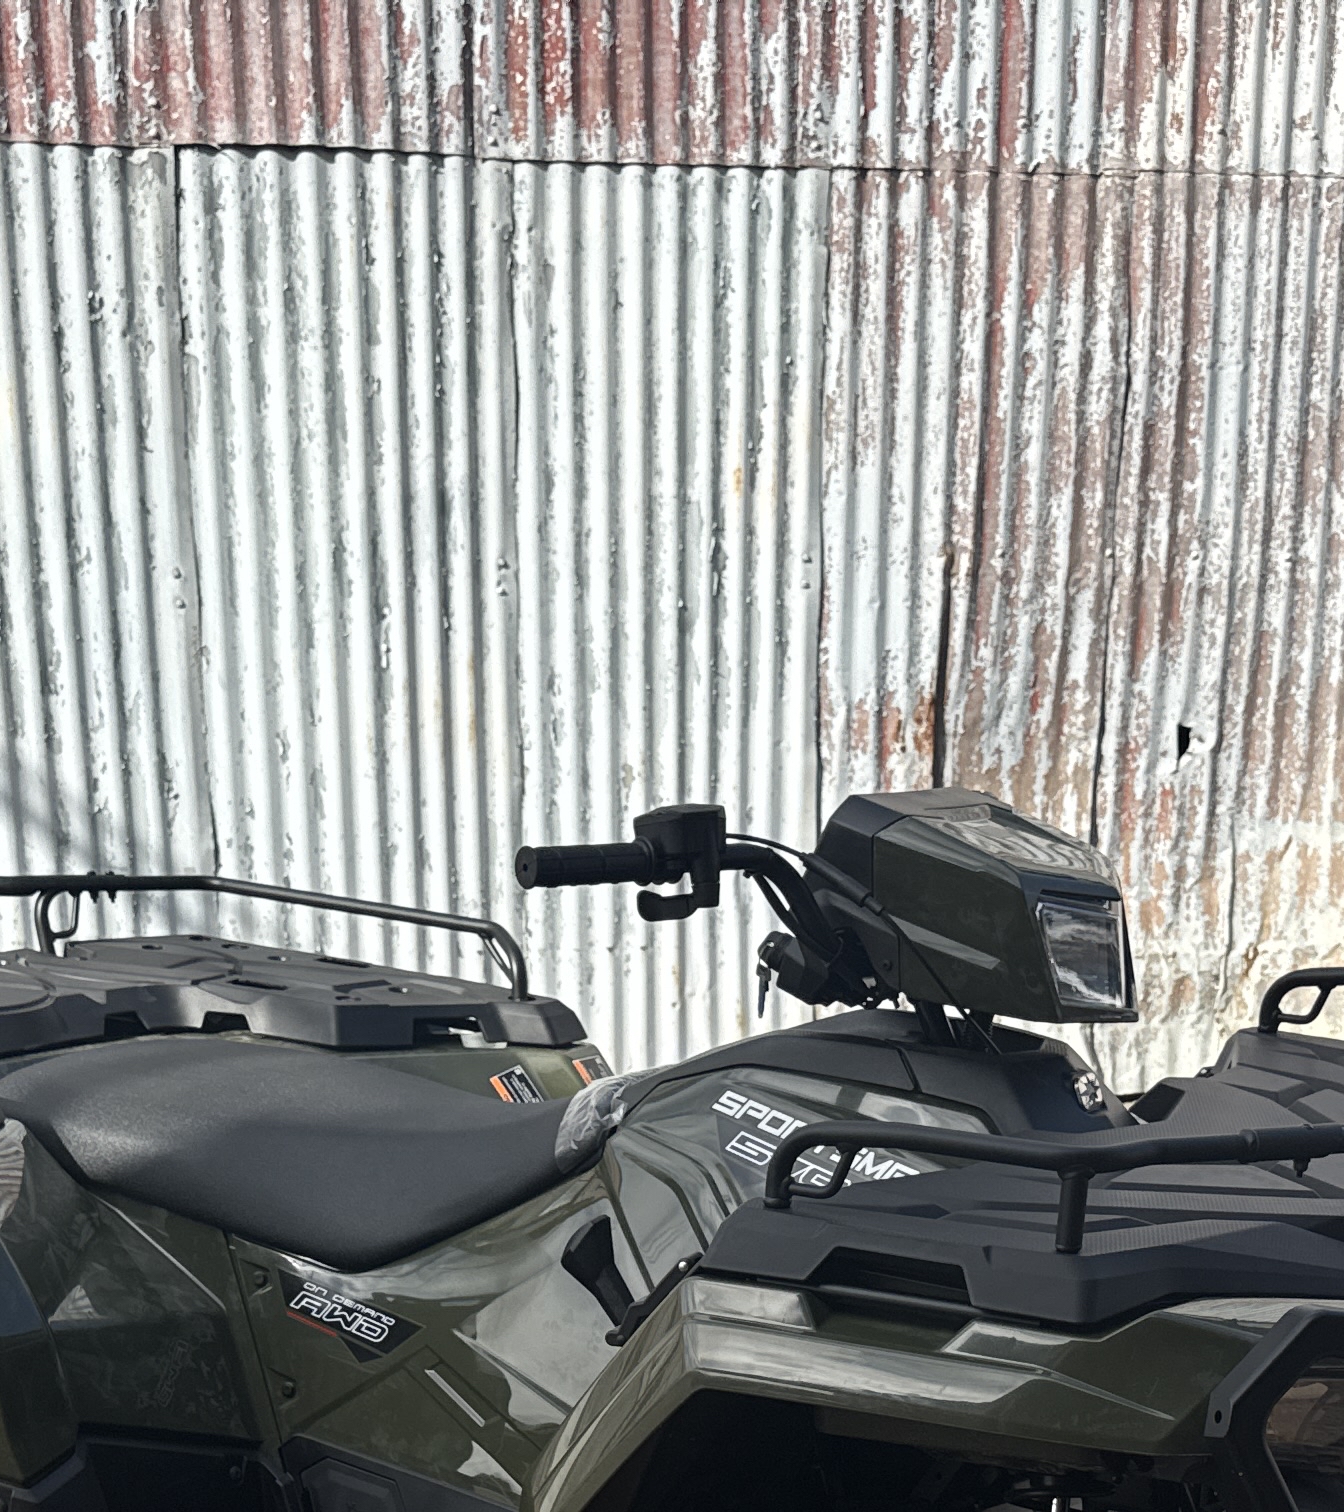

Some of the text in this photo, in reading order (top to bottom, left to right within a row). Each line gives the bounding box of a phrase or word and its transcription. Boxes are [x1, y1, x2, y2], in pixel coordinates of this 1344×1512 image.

[711, 1090, 921, 1181] SPORSMA
[289, 1290, 389, 1343] AWD
[303, 1281, 396, 1326] ON DEMAND
